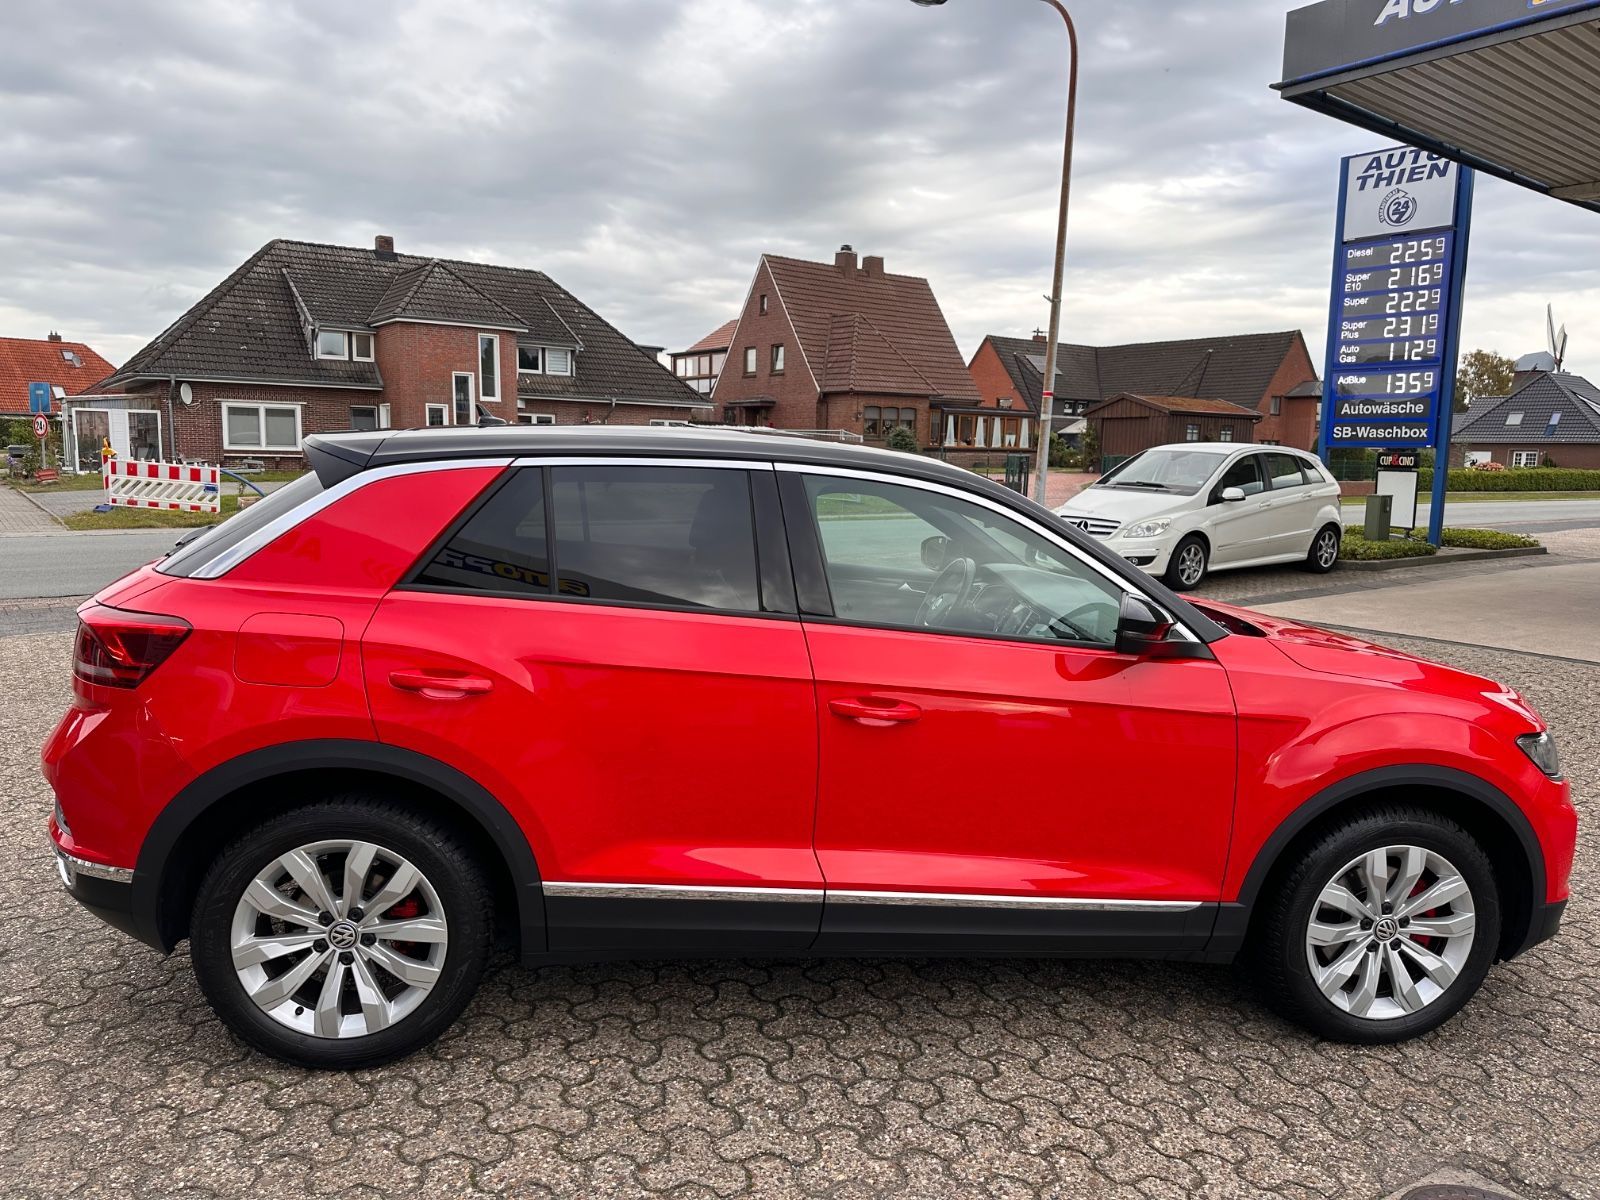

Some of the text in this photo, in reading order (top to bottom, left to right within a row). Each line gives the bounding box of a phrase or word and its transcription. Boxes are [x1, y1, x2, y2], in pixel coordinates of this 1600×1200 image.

[1356, 161, 1450, 191] THIEN
[1347, 248, 1374, 258] Diesel
[1346, 273, 1371, 284] Super
[1345, 283, 1362, 292] E10
[1343, 297, 1369, 307] Super
[1342, 321, 1367, 331] Super
[1341, 331, 1359, 339] Plus
[1340, 344, 1360, 354] Auto
[1339, 354, 1356, 363] Gas
[1338, 376, 1366, 385] AdBlue
[1341, 401, 1424, 415] Autowäsche
[1333, 426, 1428, 439] SB-Waschbox
